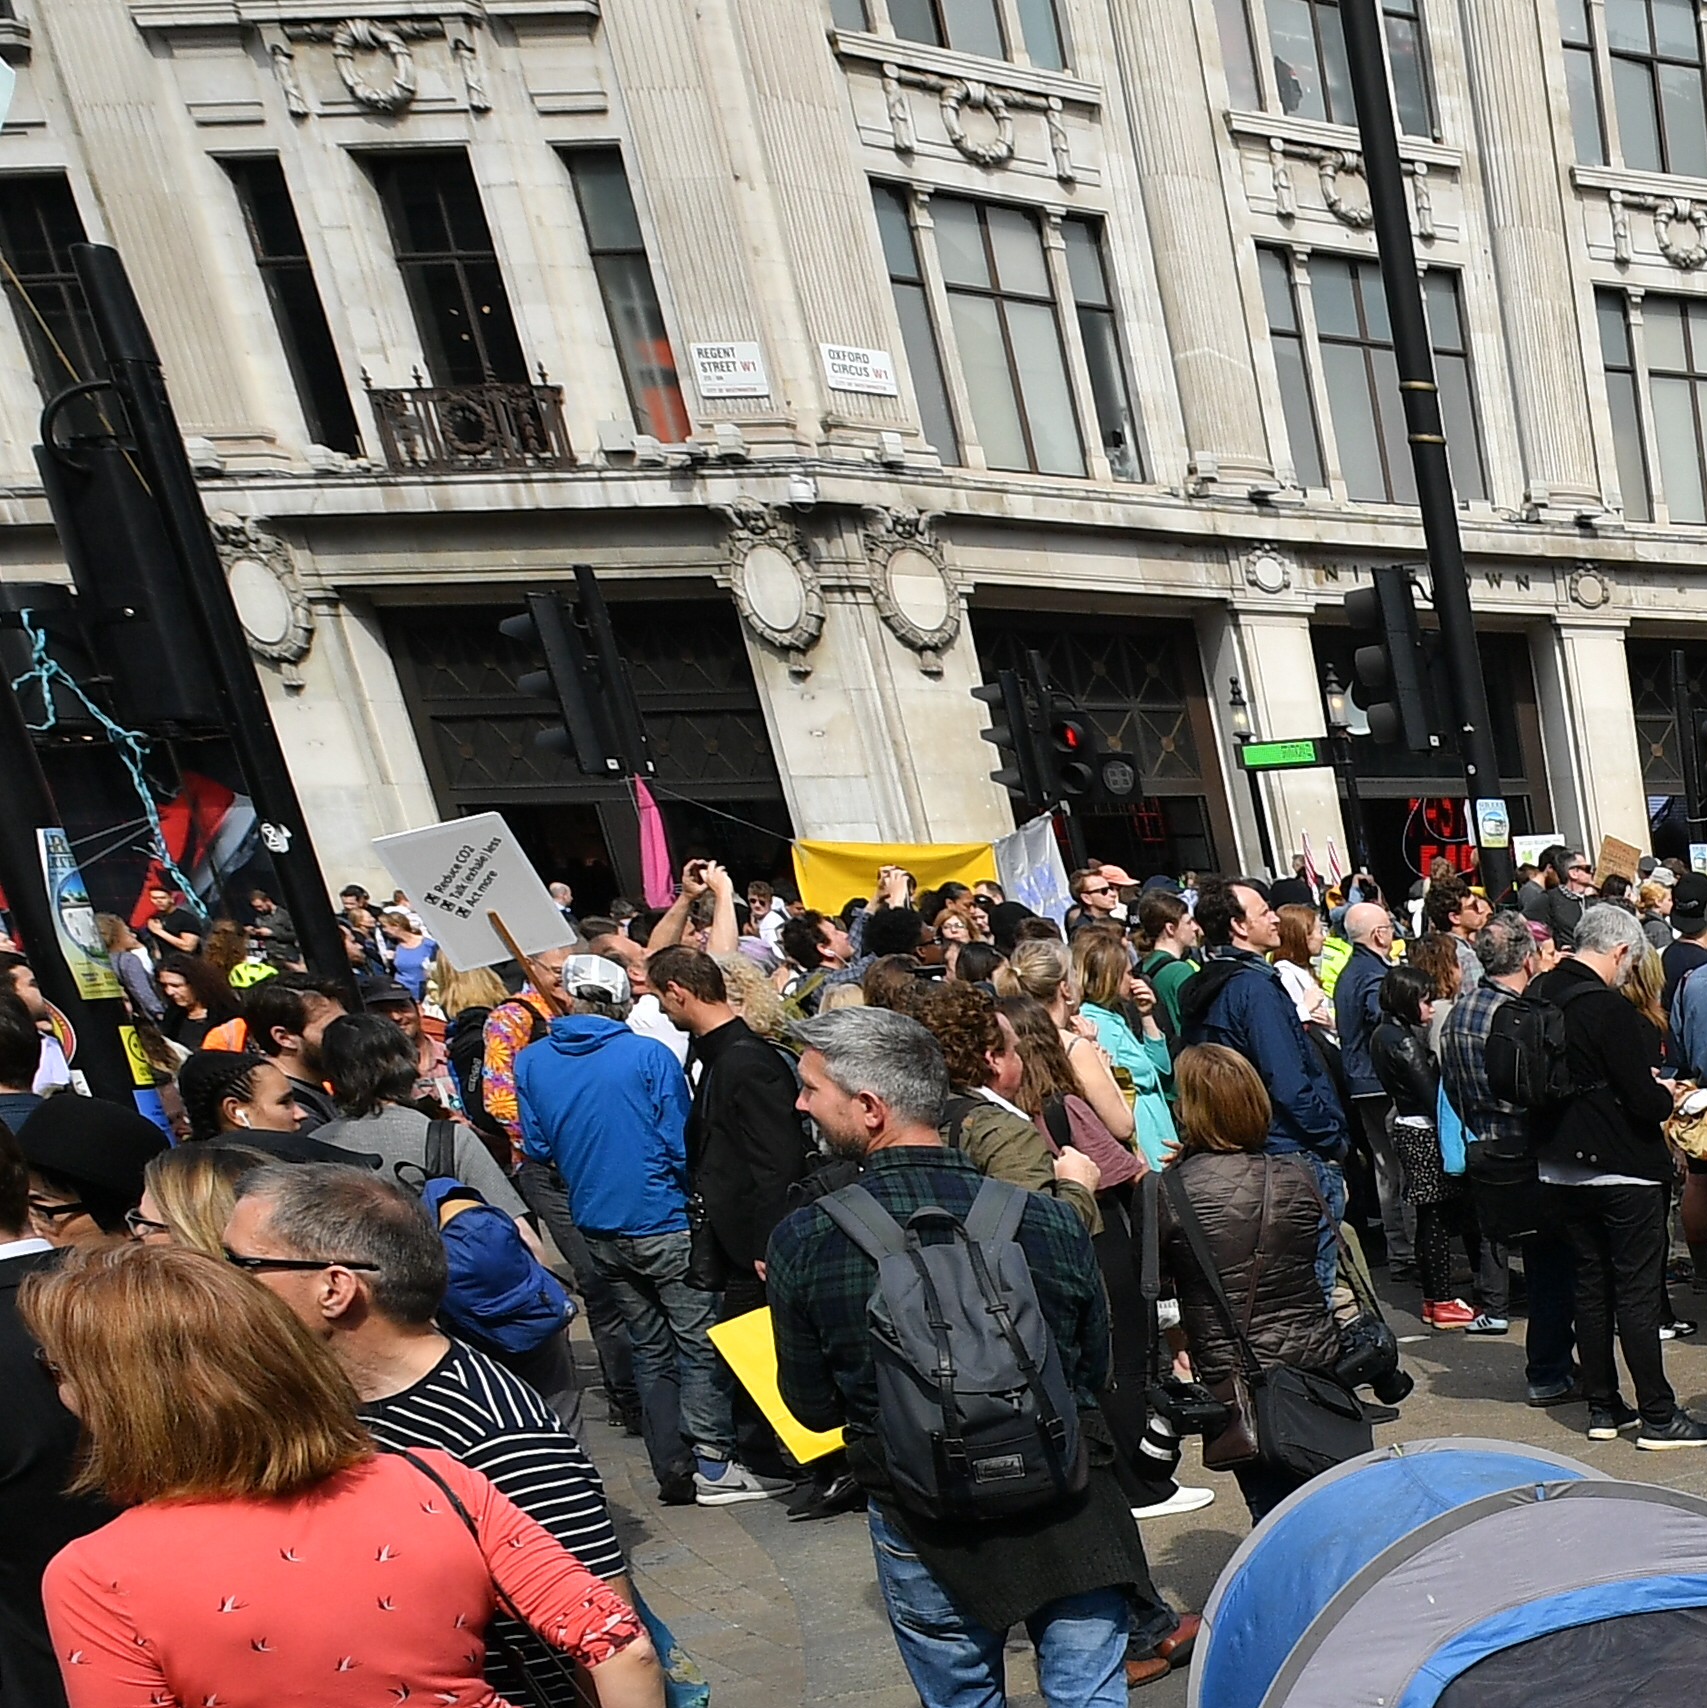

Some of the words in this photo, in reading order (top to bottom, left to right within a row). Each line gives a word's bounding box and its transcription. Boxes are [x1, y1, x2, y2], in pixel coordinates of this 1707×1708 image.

[697, 347, 735, 359] REGENT
[829, 349, 869, 364] OXFORD
[701, 361, 737, 373] STREET
[741, 361, 757, 373] W1
[832, 363, 870, 378] CIRCUS
[873, 368, 889, 380] W1
[434, 861, 463, 895] Reduce
[456, 845, 475, 866] CO2
[449, 881, 469, 901] Talk
[484, 836, 502, 857] less
[467, 892, 483, 908] Act
[480, 869, 499, 894] more
